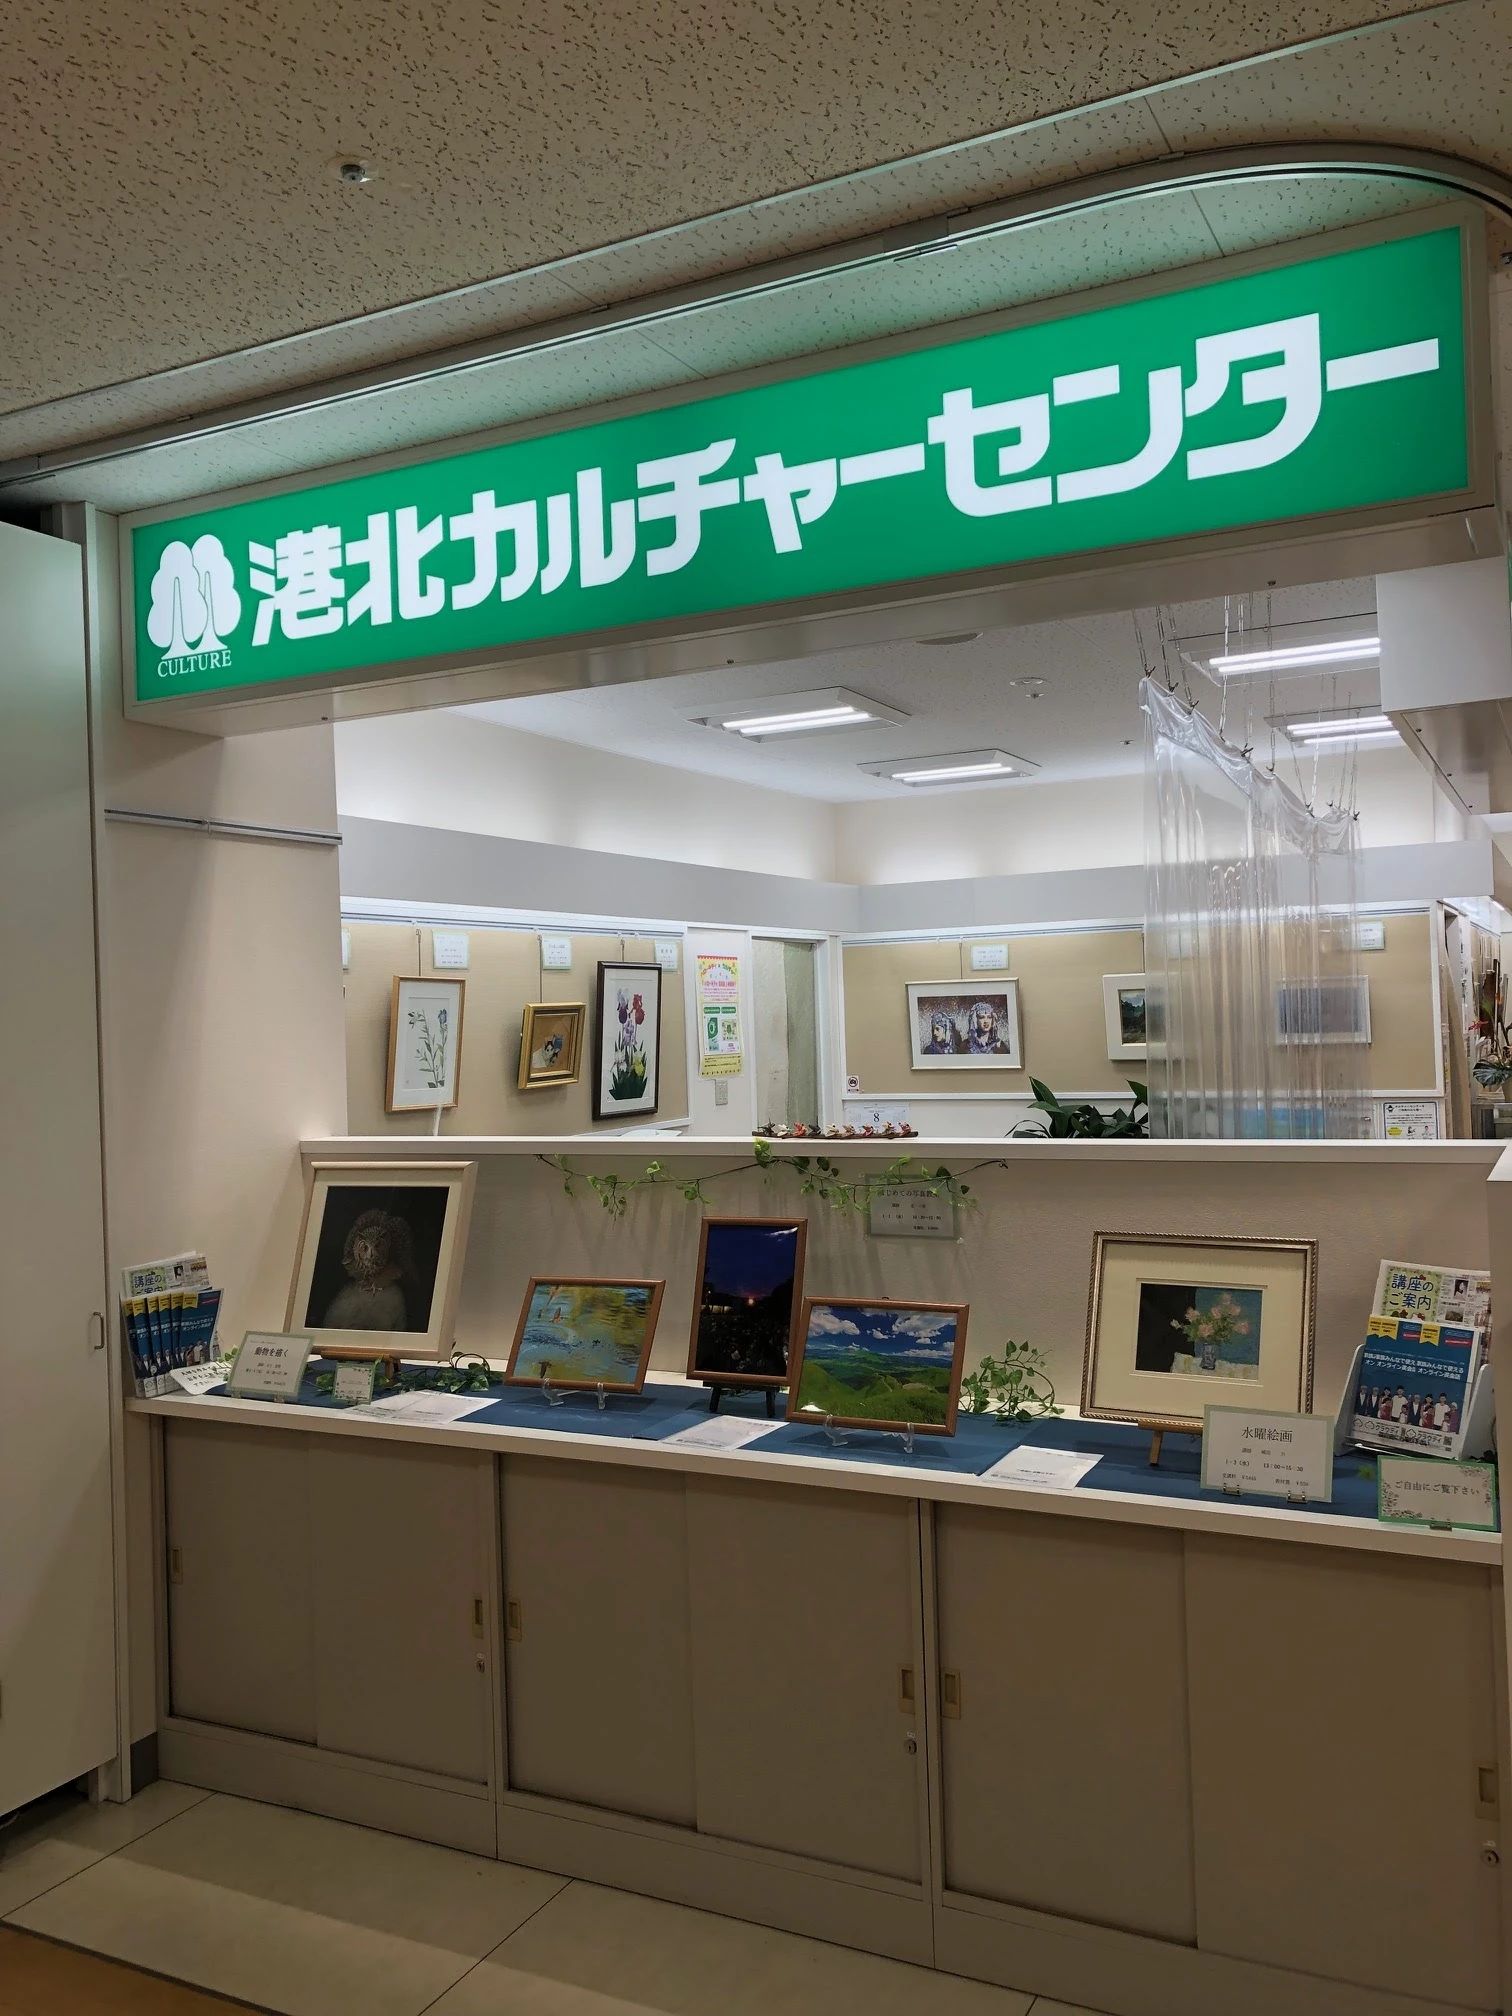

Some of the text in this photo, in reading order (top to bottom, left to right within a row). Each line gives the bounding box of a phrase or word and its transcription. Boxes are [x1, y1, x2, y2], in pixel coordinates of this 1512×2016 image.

[249, 312, 1440, 647] 港北カルチャーセンター
[157, 650, 233, 678] CULTURE
[873, 1112, 880, 1123] 8
[1391, 1273, 1434, 1292] 講座の
[1389, 1293, 1432, 1311] ご案内
[1241, 1426, 1293, 1442] 水曜絵画
[1395, 1481, 1480, 1495] ご自由にご覧下さい
